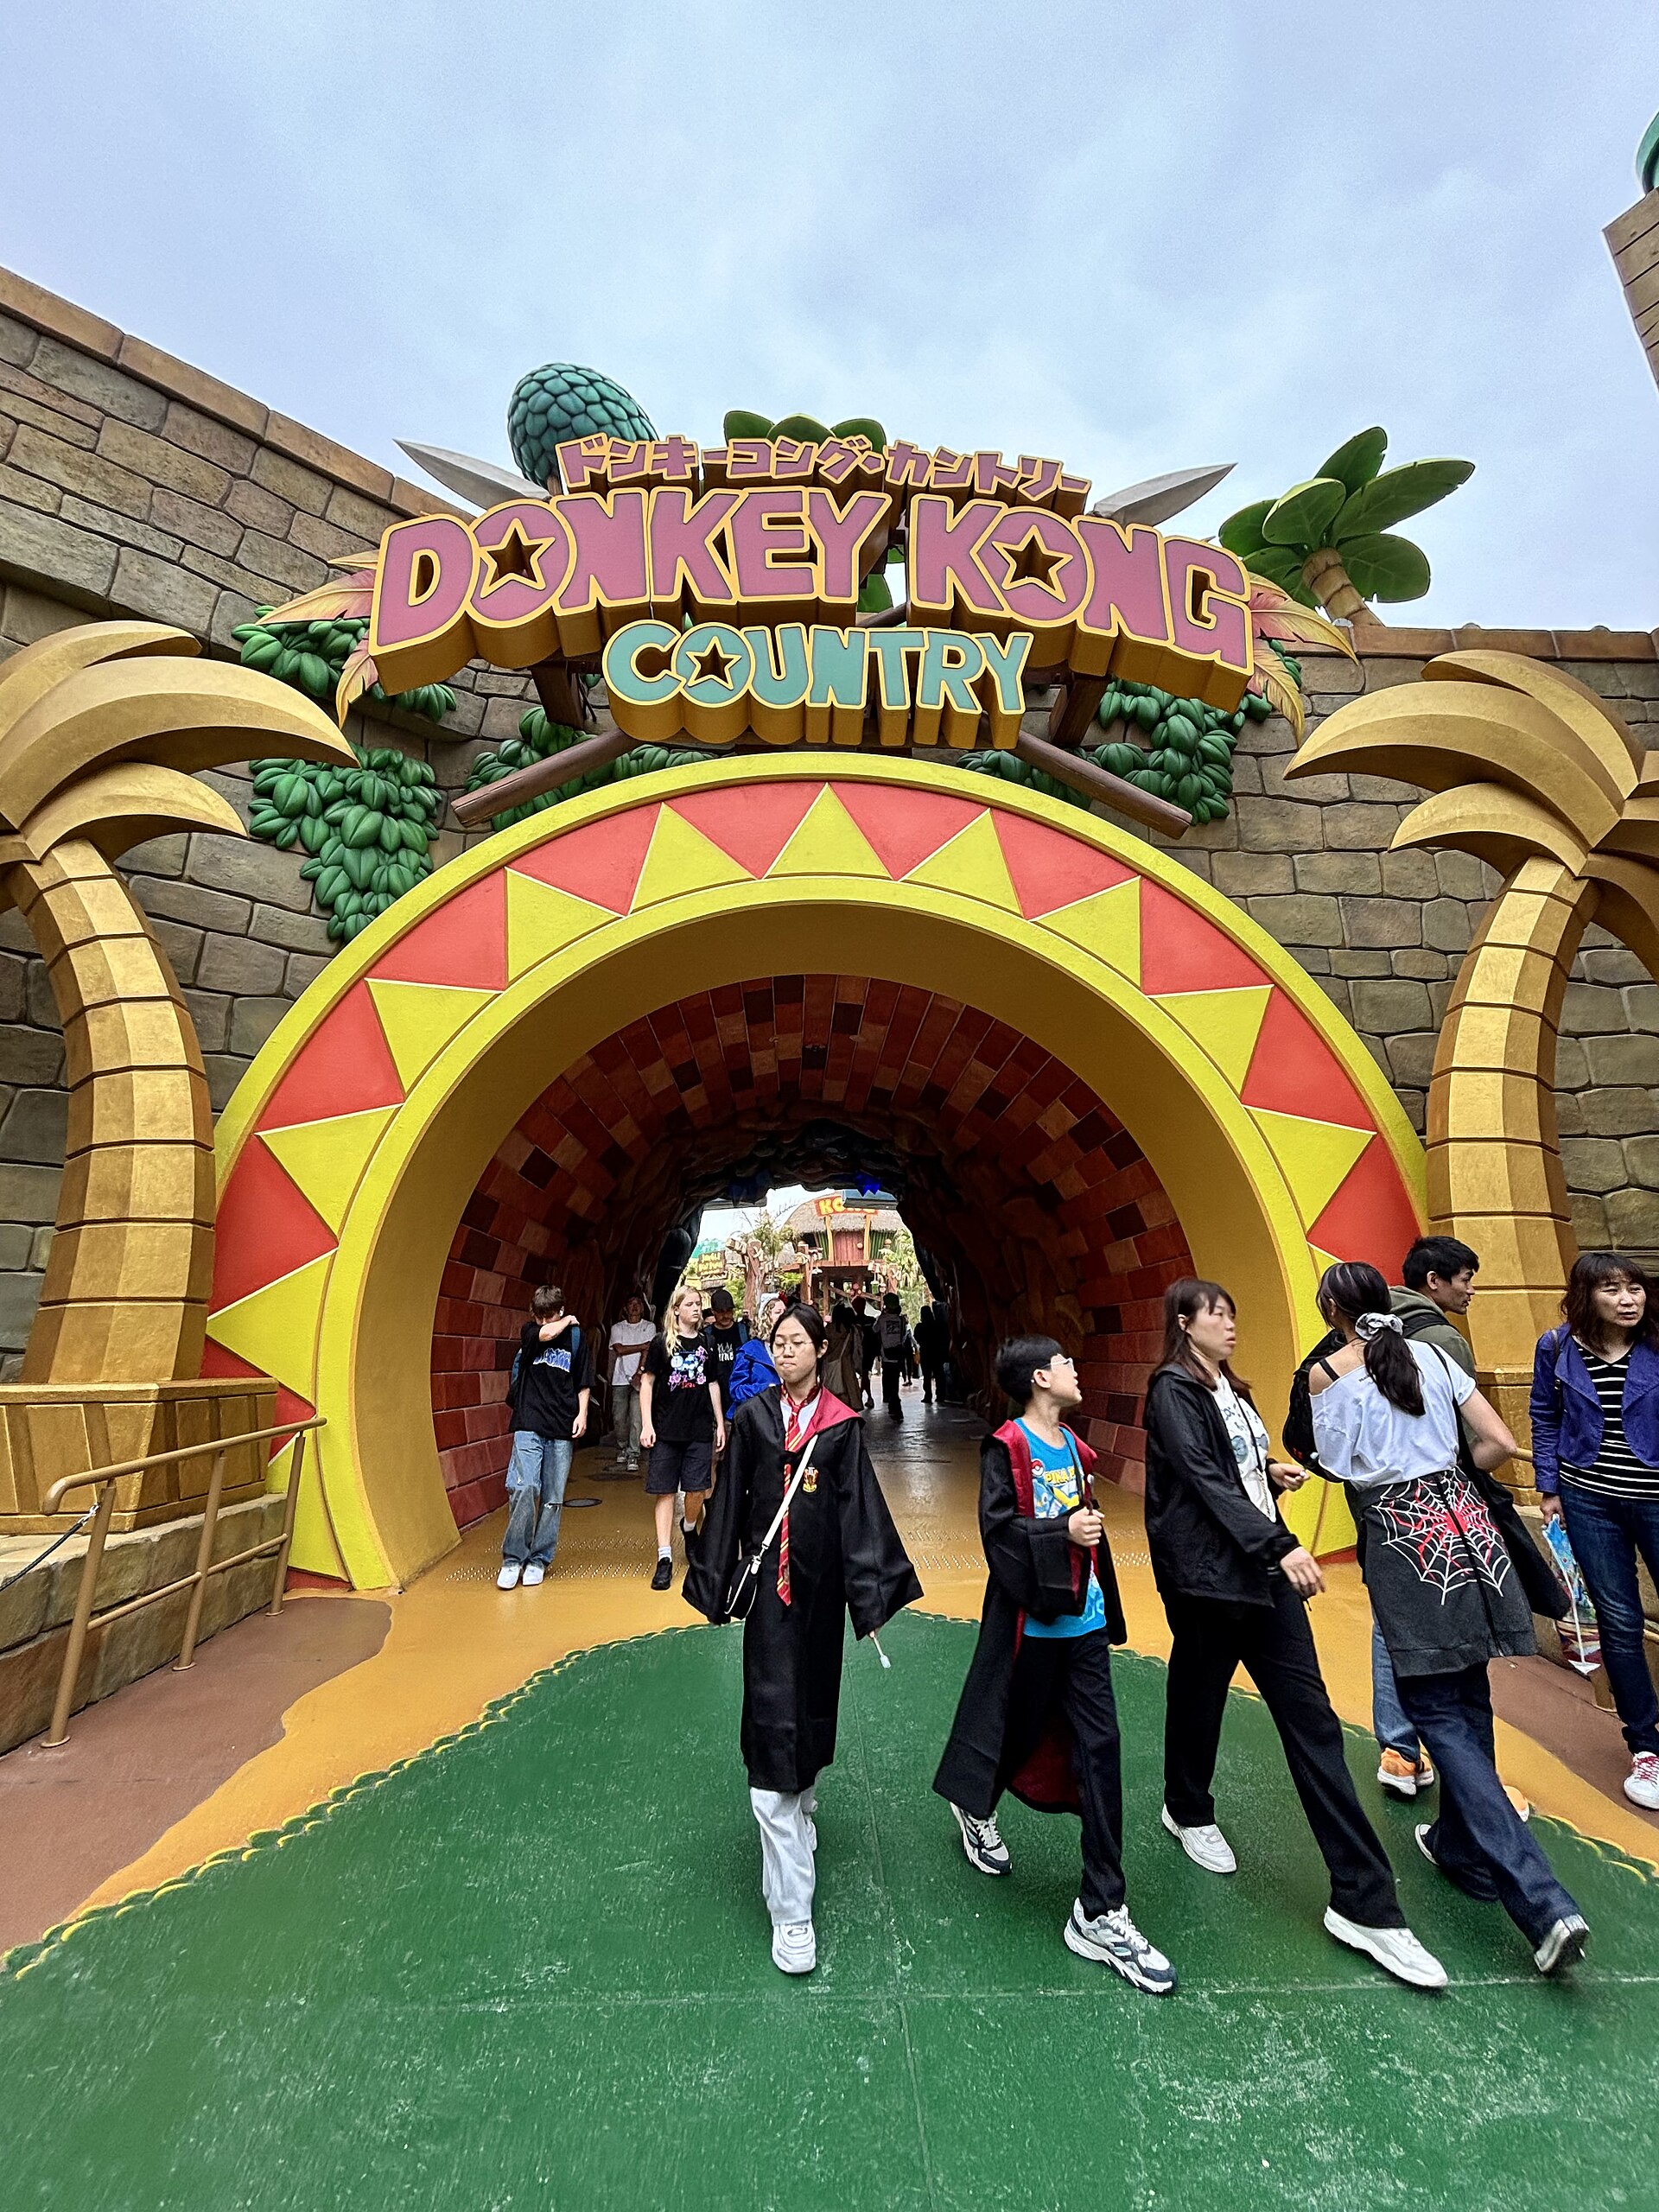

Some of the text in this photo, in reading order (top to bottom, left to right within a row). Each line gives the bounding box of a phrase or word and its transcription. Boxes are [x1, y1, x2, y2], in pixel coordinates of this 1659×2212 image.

[556, 433, 1091, 501] ドンキーコング・カントリー
[369, 486, 1255, 676] DONKEY KONG
[602, 620, 1034, 715] COUNTRY
